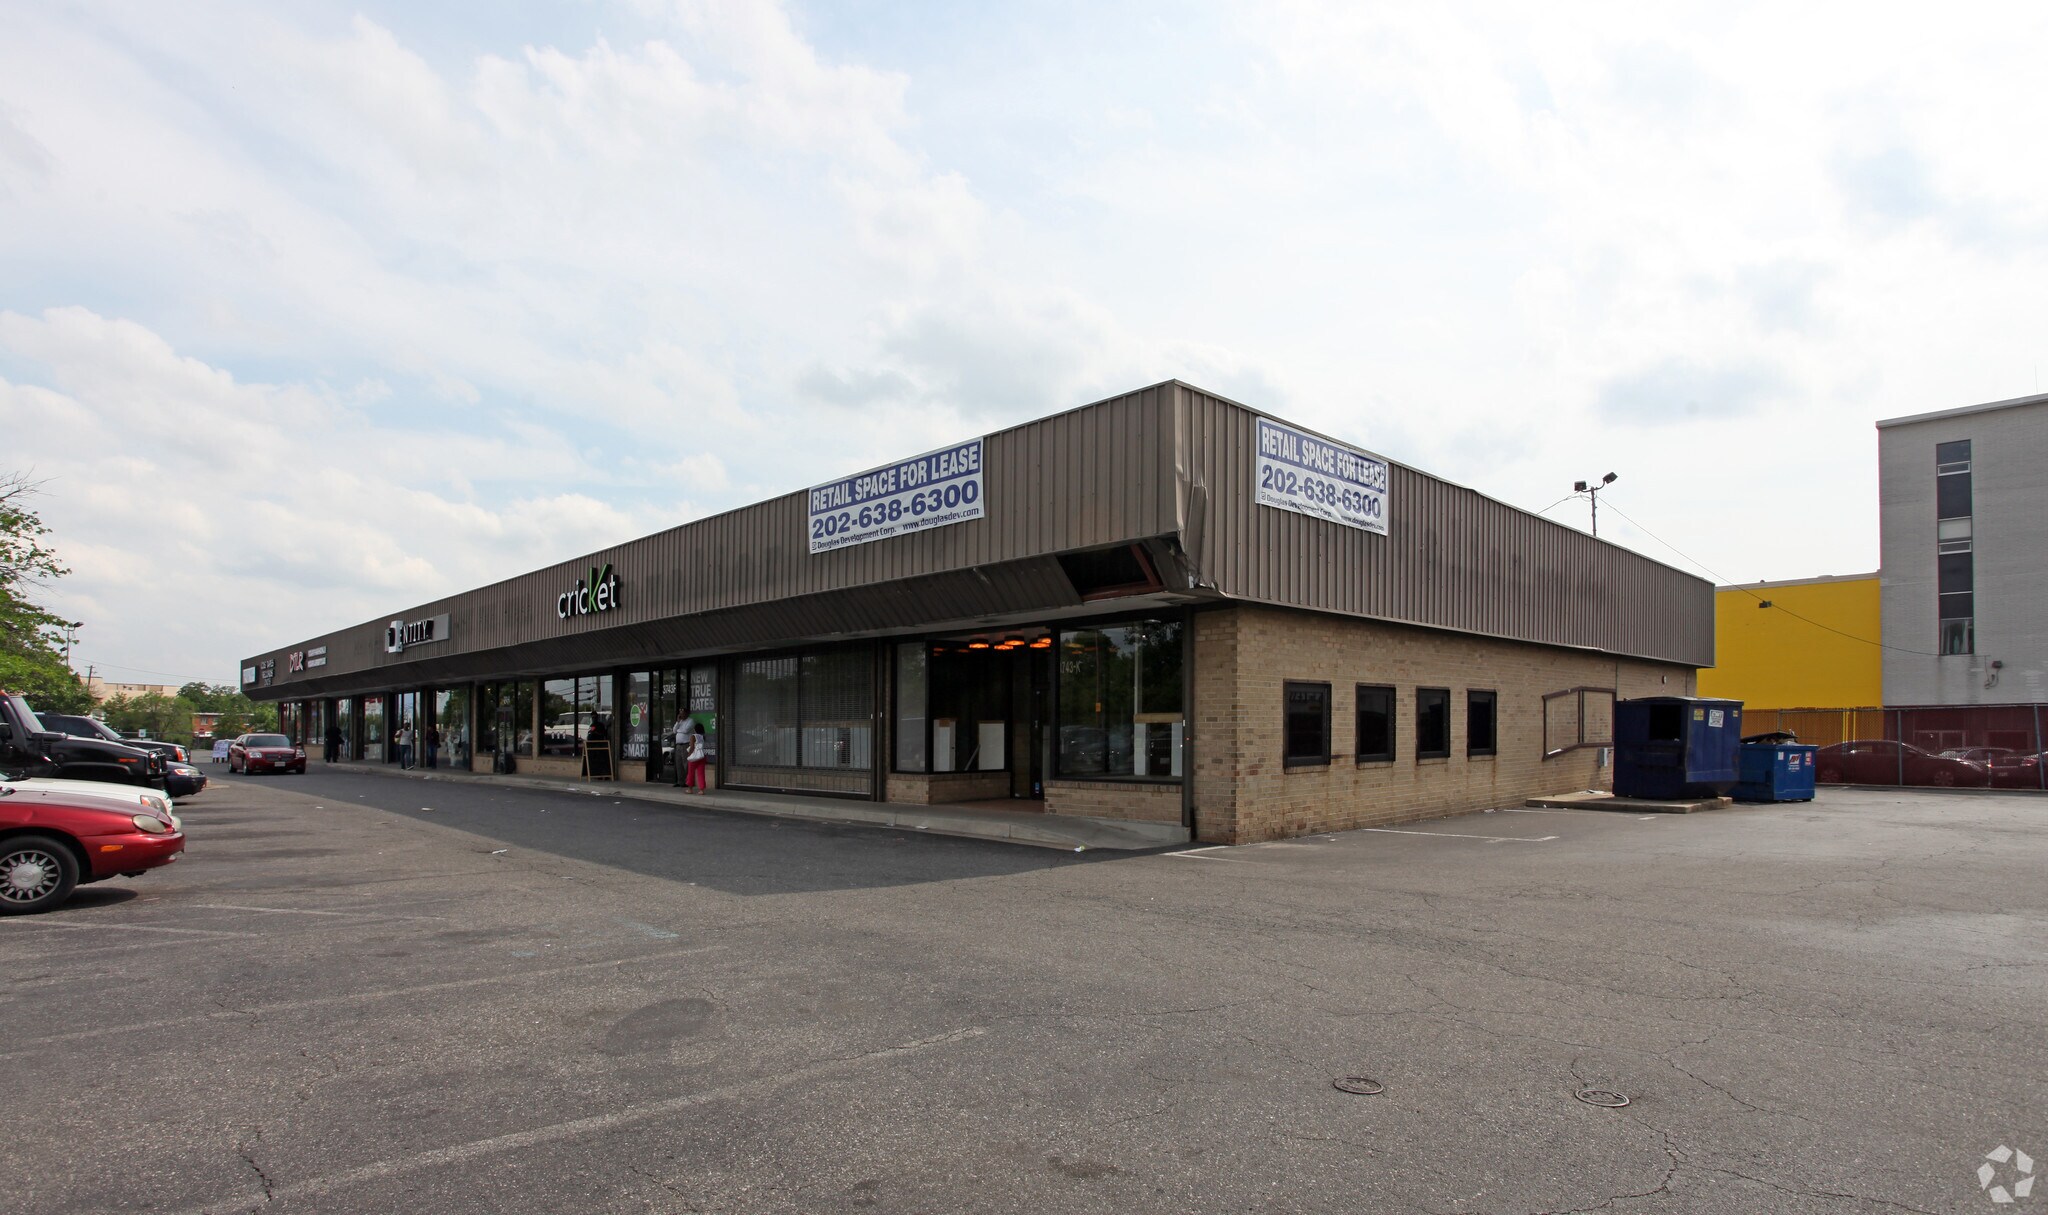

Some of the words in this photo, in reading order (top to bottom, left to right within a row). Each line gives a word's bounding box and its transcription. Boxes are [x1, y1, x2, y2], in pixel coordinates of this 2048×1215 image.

[1262, 426, 1300, 463] RETAIL
[1302, 439, 1335, 475] SPACE
[1337, 451, 1356, 480] FOR
[1358, 458, 1386, 490] LEASE
[812, 482, 852, 512] RETAIL
[855, 468, 896, 502] SPACE
[900, 459, 928, 489] FOR
[931, 444, 980, 481] LEASE
[1261, 464, 1382, 520] 202-638-6300
[1266, 494, 1288, 508] Douglas
[812, 480, 979, 540] 202-638-6300
[902, 507, 979, 531] www.douglasdev.com
[817, 538, 840, 550] Douglas
[840, 529, 879, 546] Development
[880, 525, 897, 538] Corp.
[557, 564, 616, 619] cricket
[690, 671, 708, 684] NEW
[690, 684, 711, 698] TRUE
[690, 698, 715, 711] RATES
